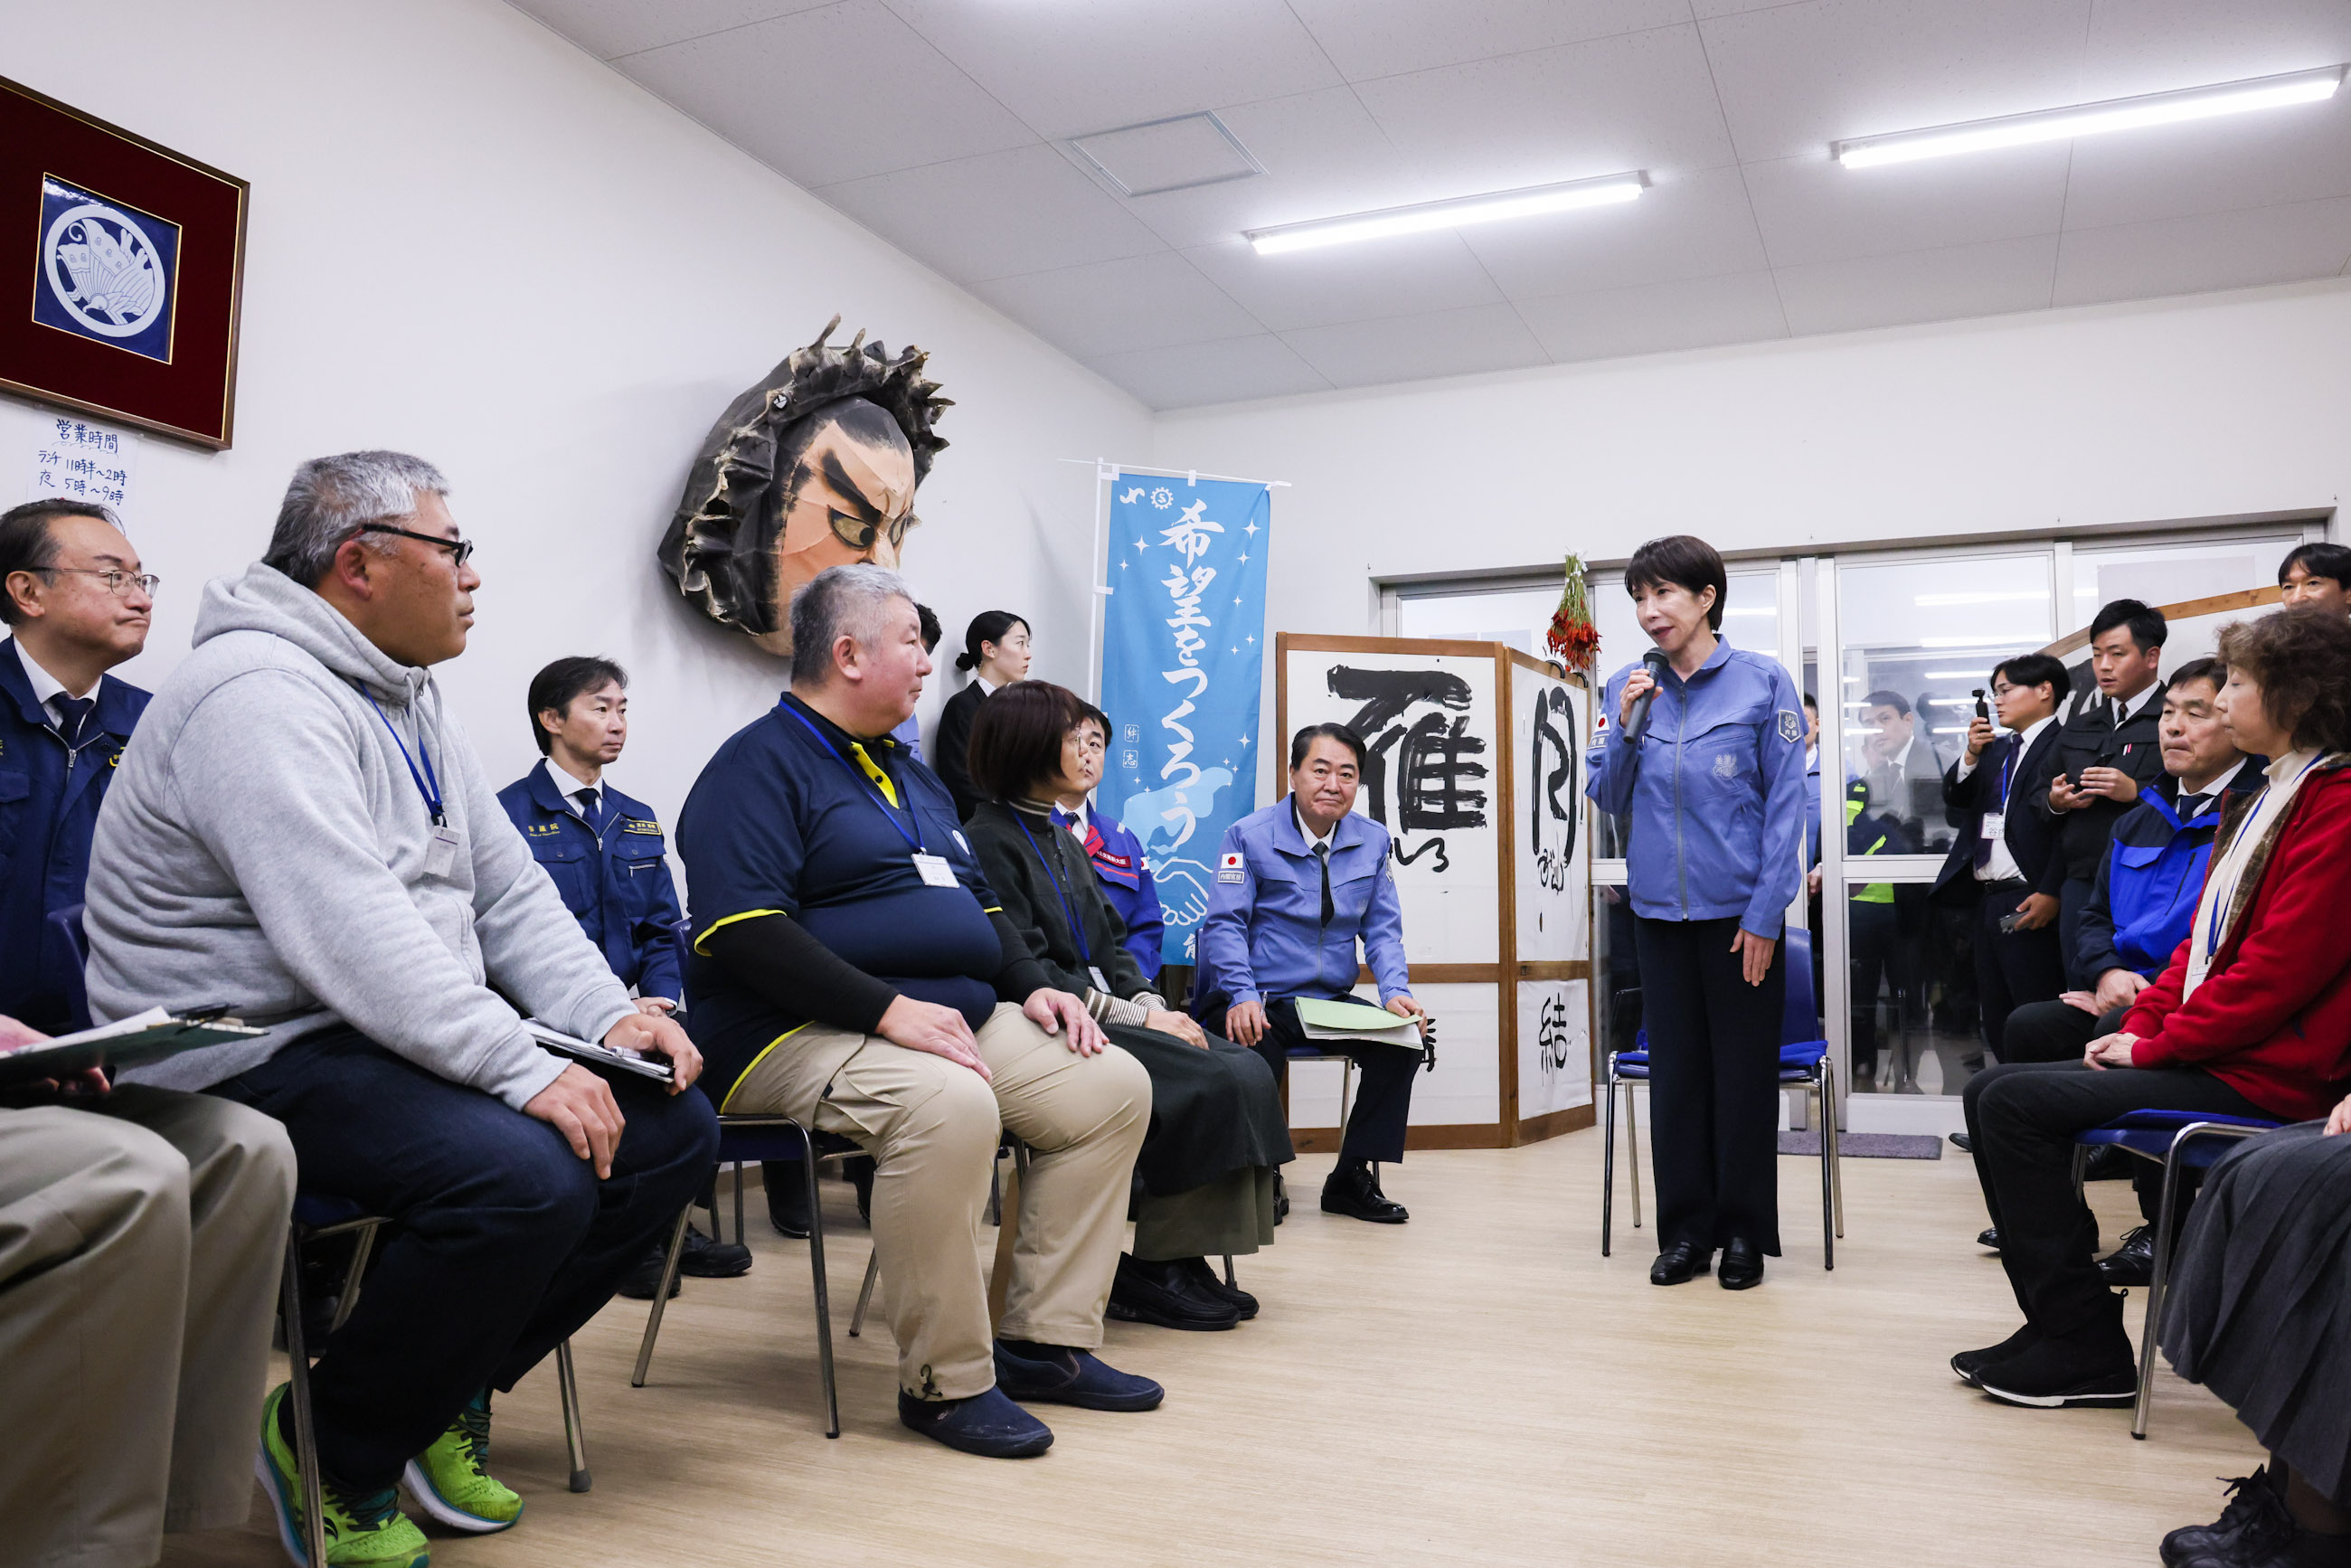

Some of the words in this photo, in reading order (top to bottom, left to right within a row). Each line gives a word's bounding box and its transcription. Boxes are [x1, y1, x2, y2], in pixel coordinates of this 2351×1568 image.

[56, 419, 118, 453] 営業時間
[38, 449, 62, 466] ランチ
[39, 469, 56, 487] 夜
[1159, 498, 1225, 848] 希望をつくろう
